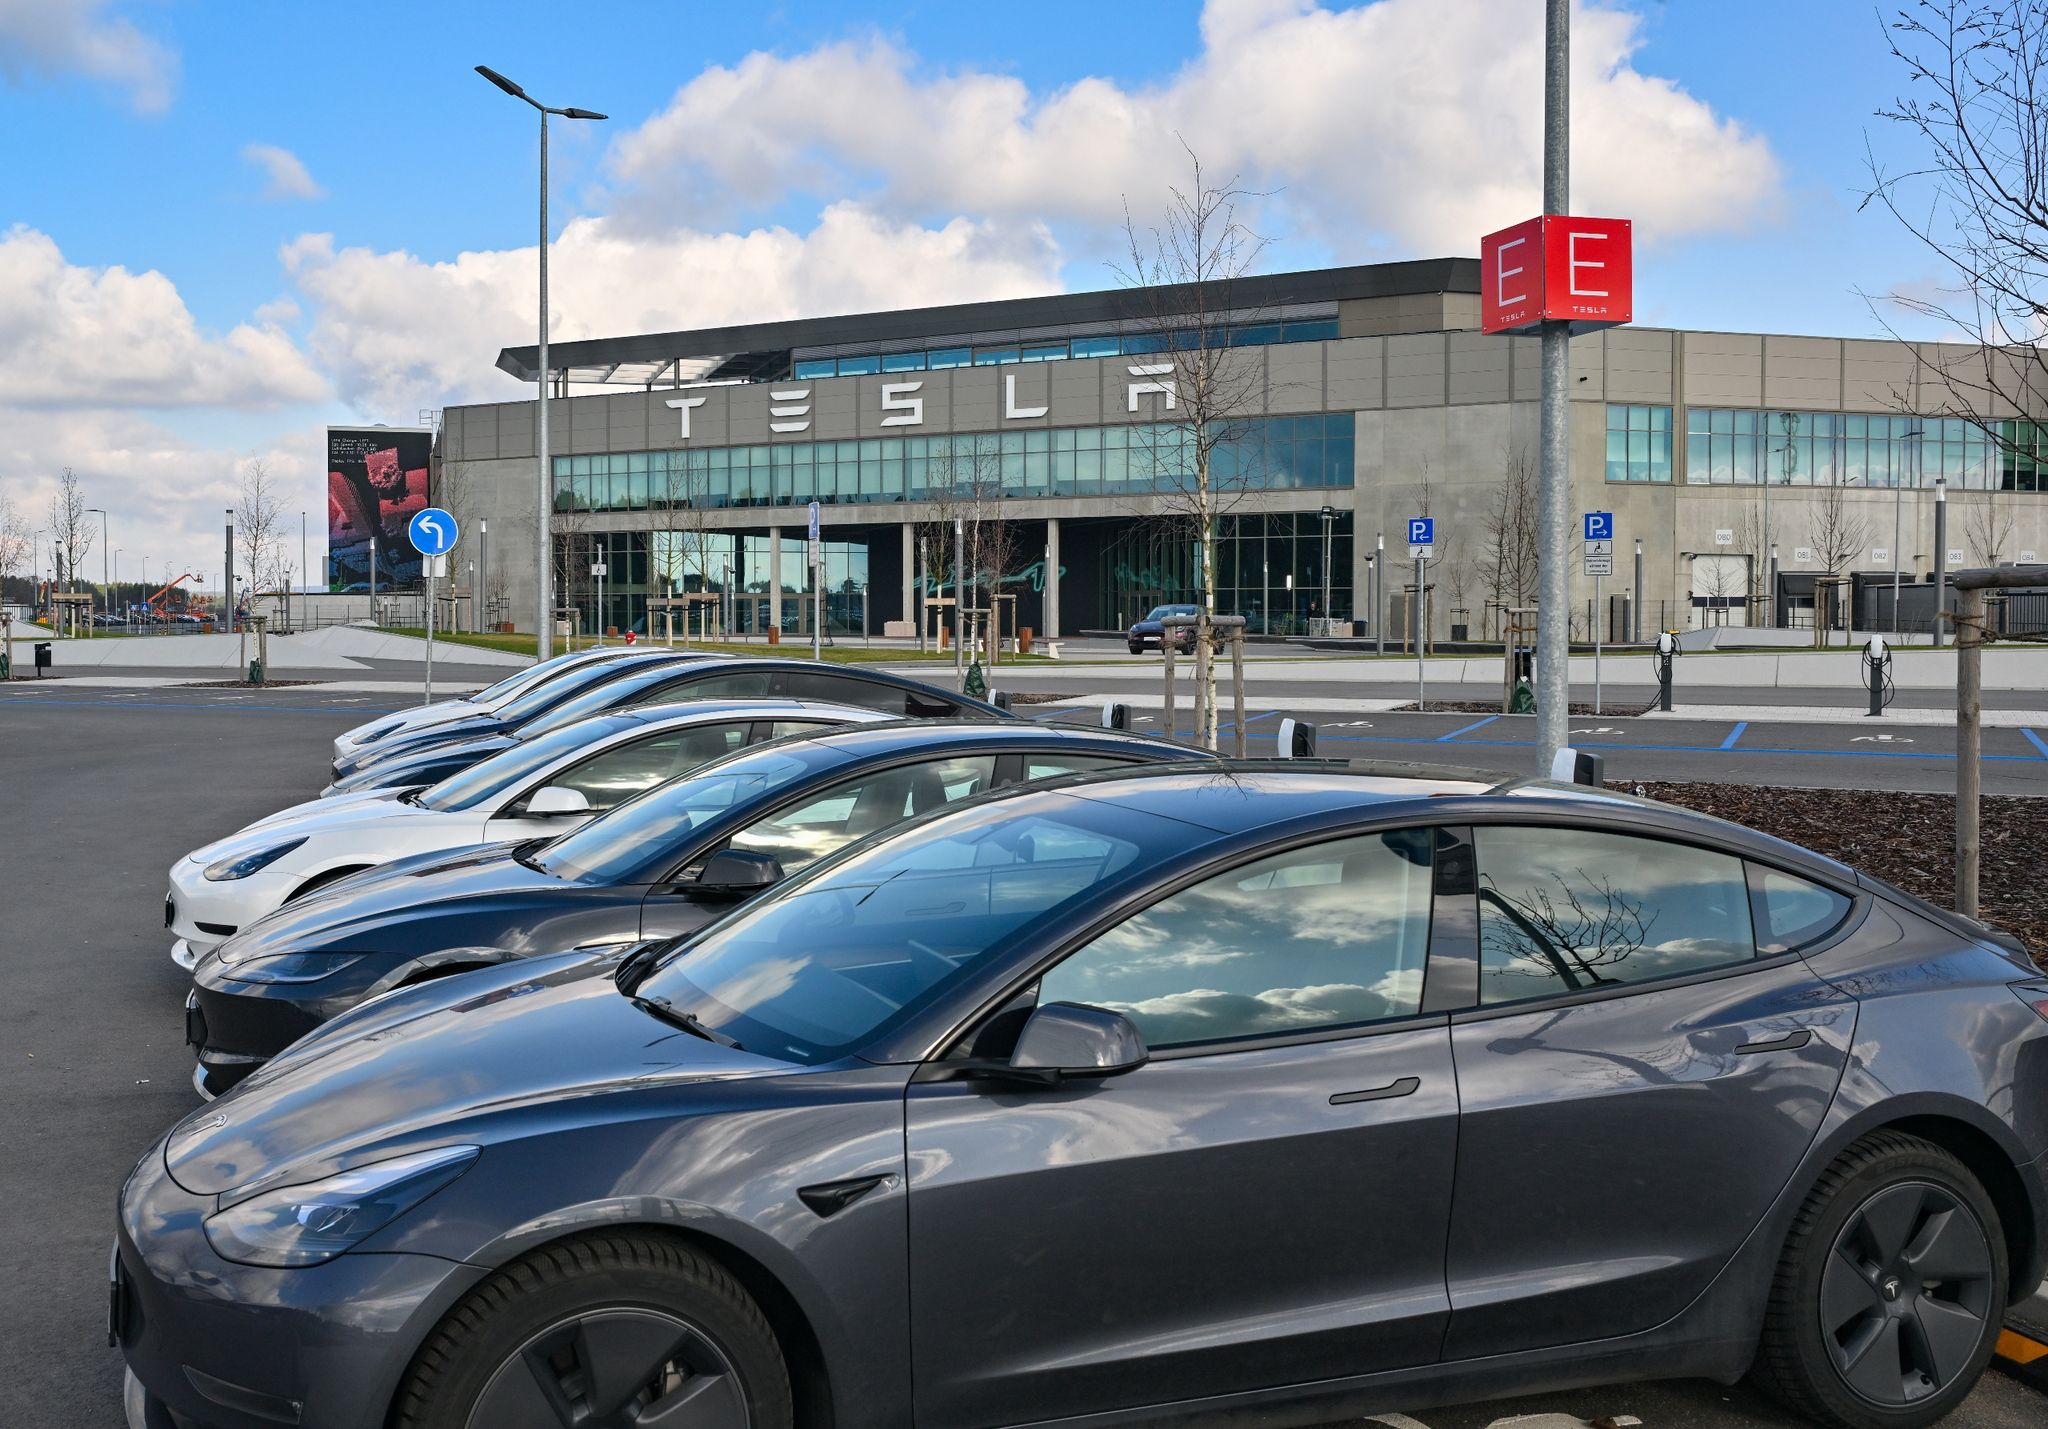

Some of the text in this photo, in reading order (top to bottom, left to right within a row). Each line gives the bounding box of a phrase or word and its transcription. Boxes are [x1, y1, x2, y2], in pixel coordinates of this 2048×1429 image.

[1498, 237, 1526, 307] E
[1569, 232, 1608, 296] E
[1500, 310, 1525, 323] TESLA
[1572, 306, 1607, 314] TESLA
[665, 363, 1176, 439] TESLA
[1413, 522, 1426, 541] P
[1589, 517, 1604, 536] P
[1716, 533, 1732, 541] 080
[1873, 552, 1887, 560] 082
